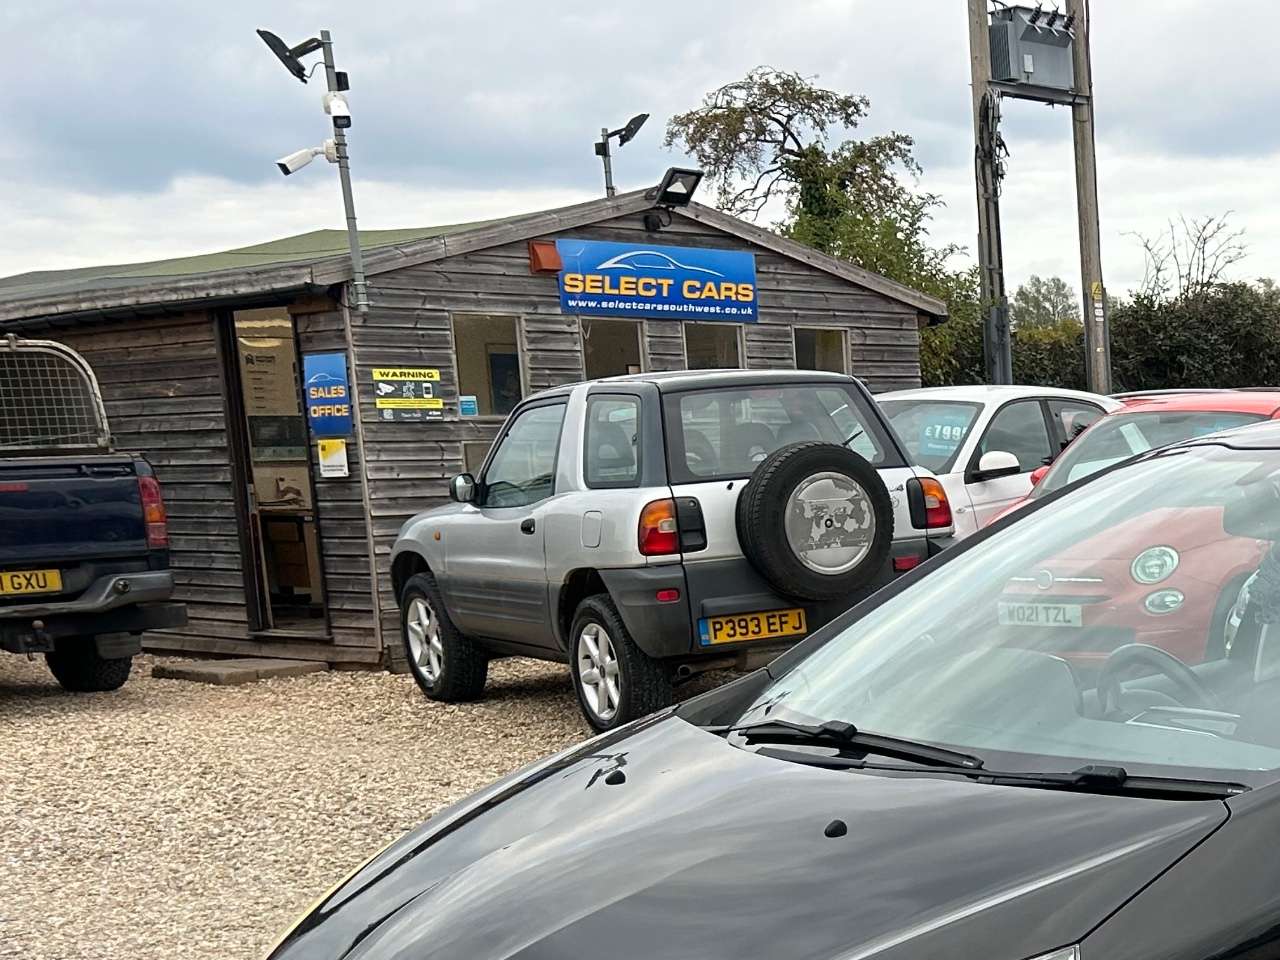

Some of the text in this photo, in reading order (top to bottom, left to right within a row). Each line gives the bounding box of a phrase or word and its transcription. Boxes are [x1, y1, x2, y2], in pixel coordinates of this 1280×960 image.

[563, 273, 754, 302] SELECT CARS
[567, 299, 753, 315] www.selectcarssouthwest.co.uk
[379, 370, 435, 379] WARNING
[309, 385, 346, 399] SALES
[310, 404, 349, 418] OFFICE
[10, 573, 48, 590] GXU
[1042, 606, 1072, 623] TZL
[712, 612, 803, 640] P393 EFJ
